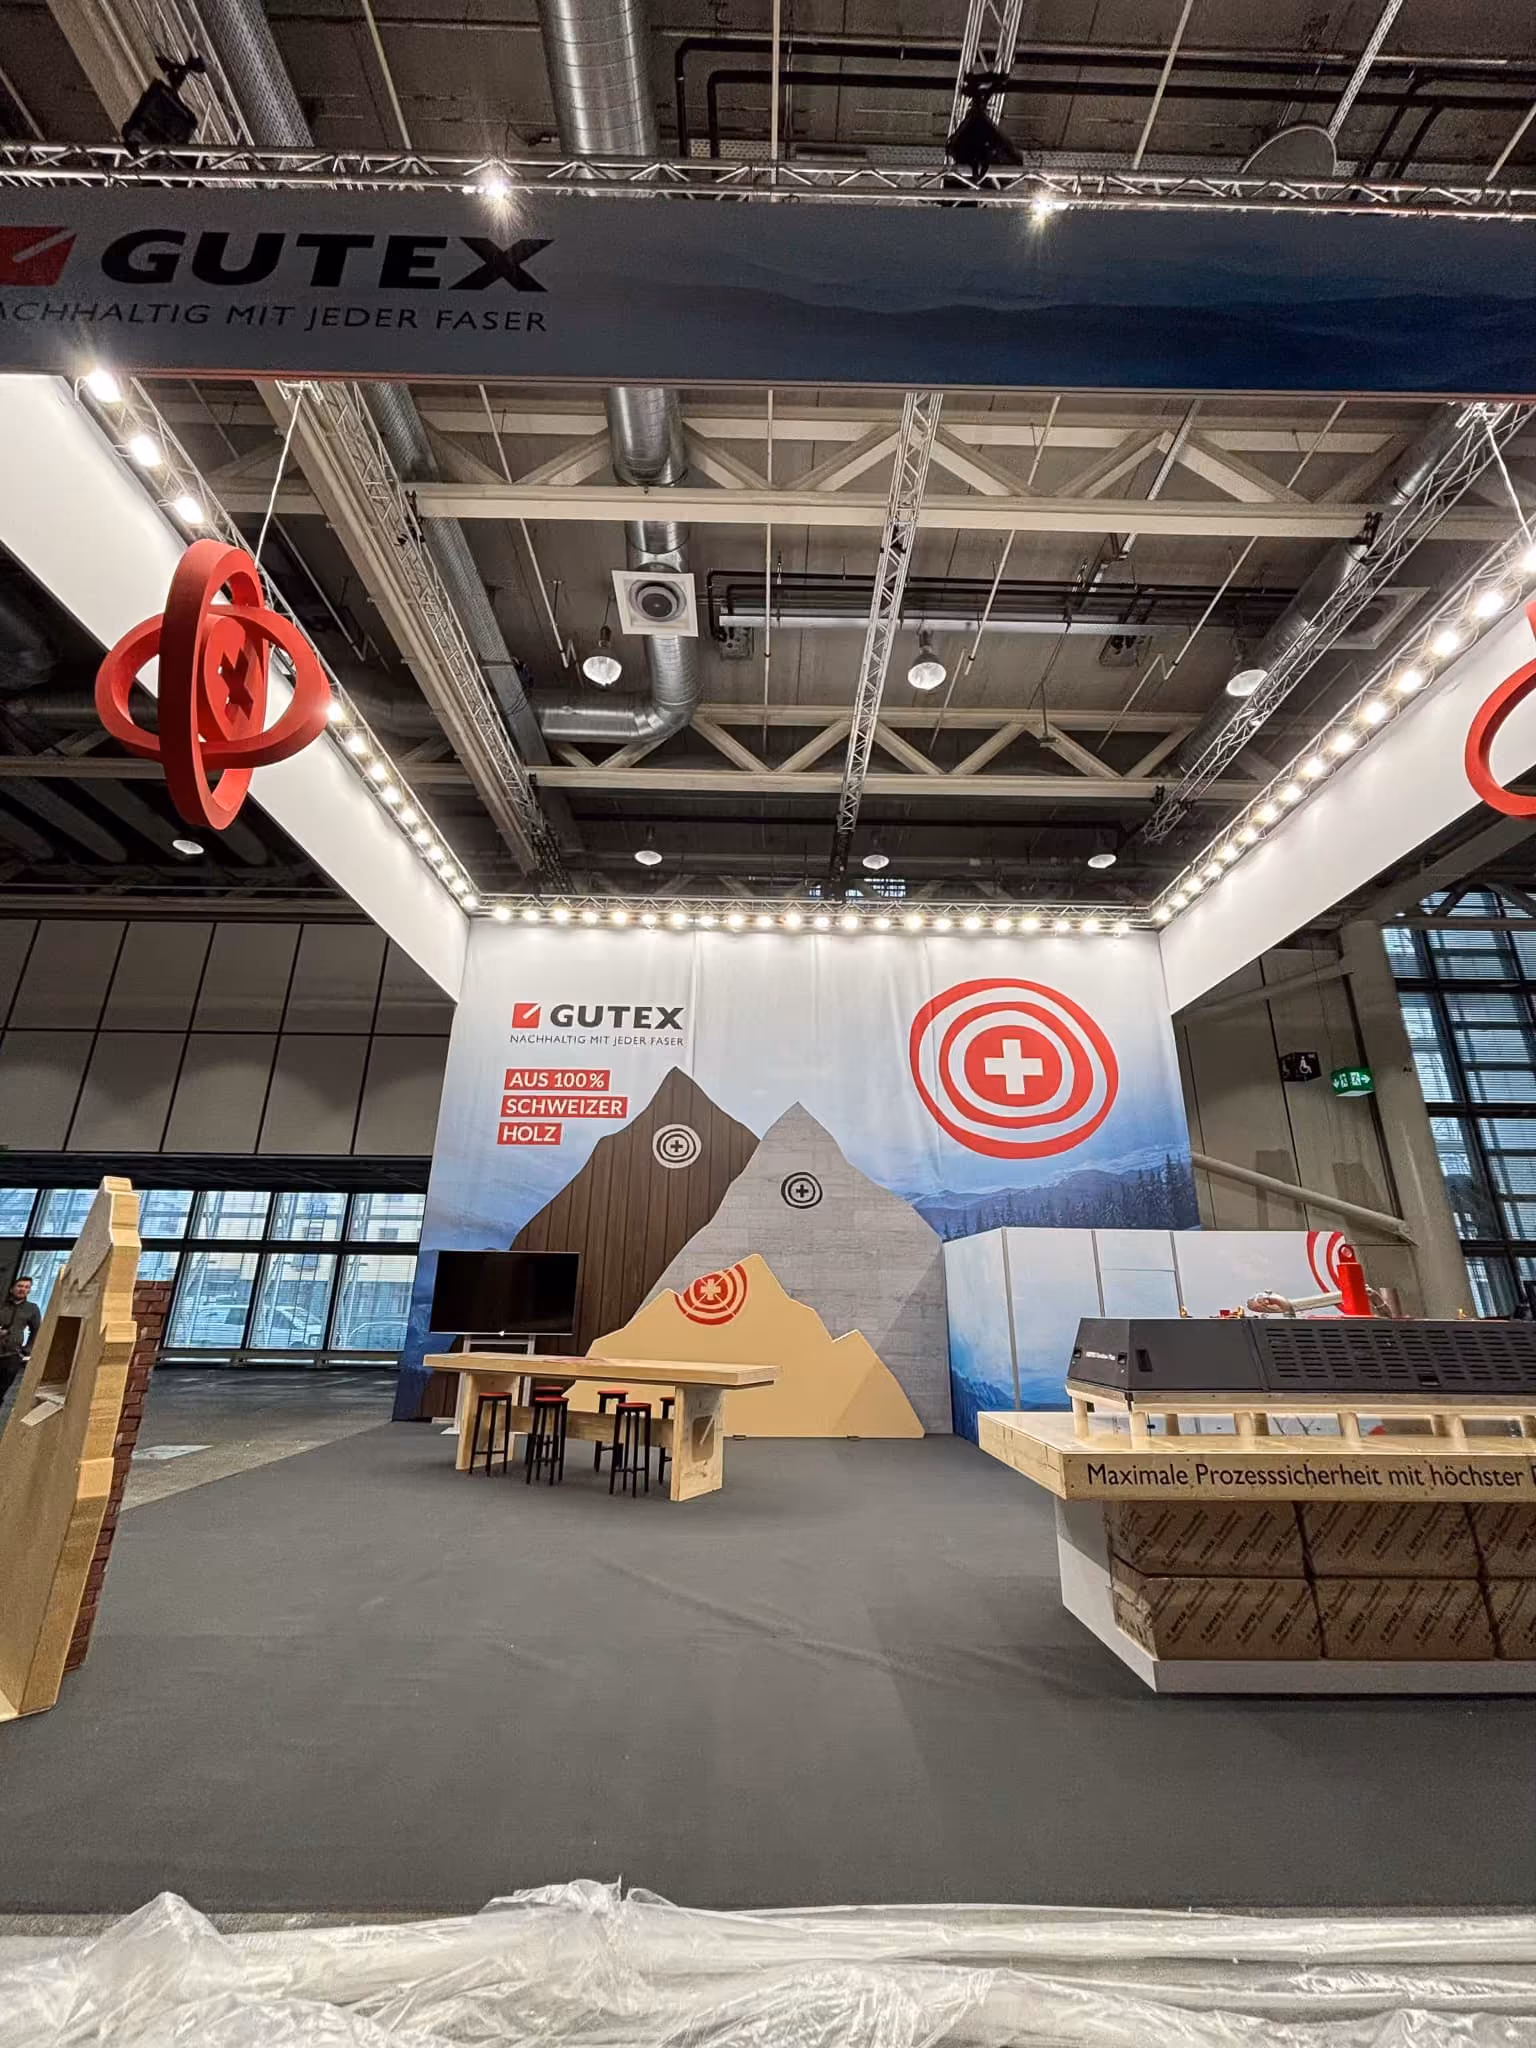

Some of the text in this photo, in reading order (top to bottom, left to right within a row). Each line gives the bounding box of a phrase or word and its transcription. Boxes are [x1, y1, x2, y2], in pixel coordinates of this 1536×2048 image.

[101, 228, 555, 293] GUTEX
[227, 304, 295, 327] MIT
[305, 306, 418, 331] JEDER
[436, 309, 548, 332] FASER
[550, 1004, 684, 1030] GUTEX
[510, 1034, 684, 1047] NACHHALTIG MIT JEDER FASER
[509, 1072, 549, 1088] AUS
[506, 1099, 622, 1115] SCHWEIZER
[502, 1126, 556, 1142] HOLZ
[1087, 1464, 1189, 1486] Maximale
[1195, 1464, 1383, 1487] Prozesssicherheit
[1388, 1465, 1425, 1486] mit
[1429, 1464, 1524, 1487] höchster
